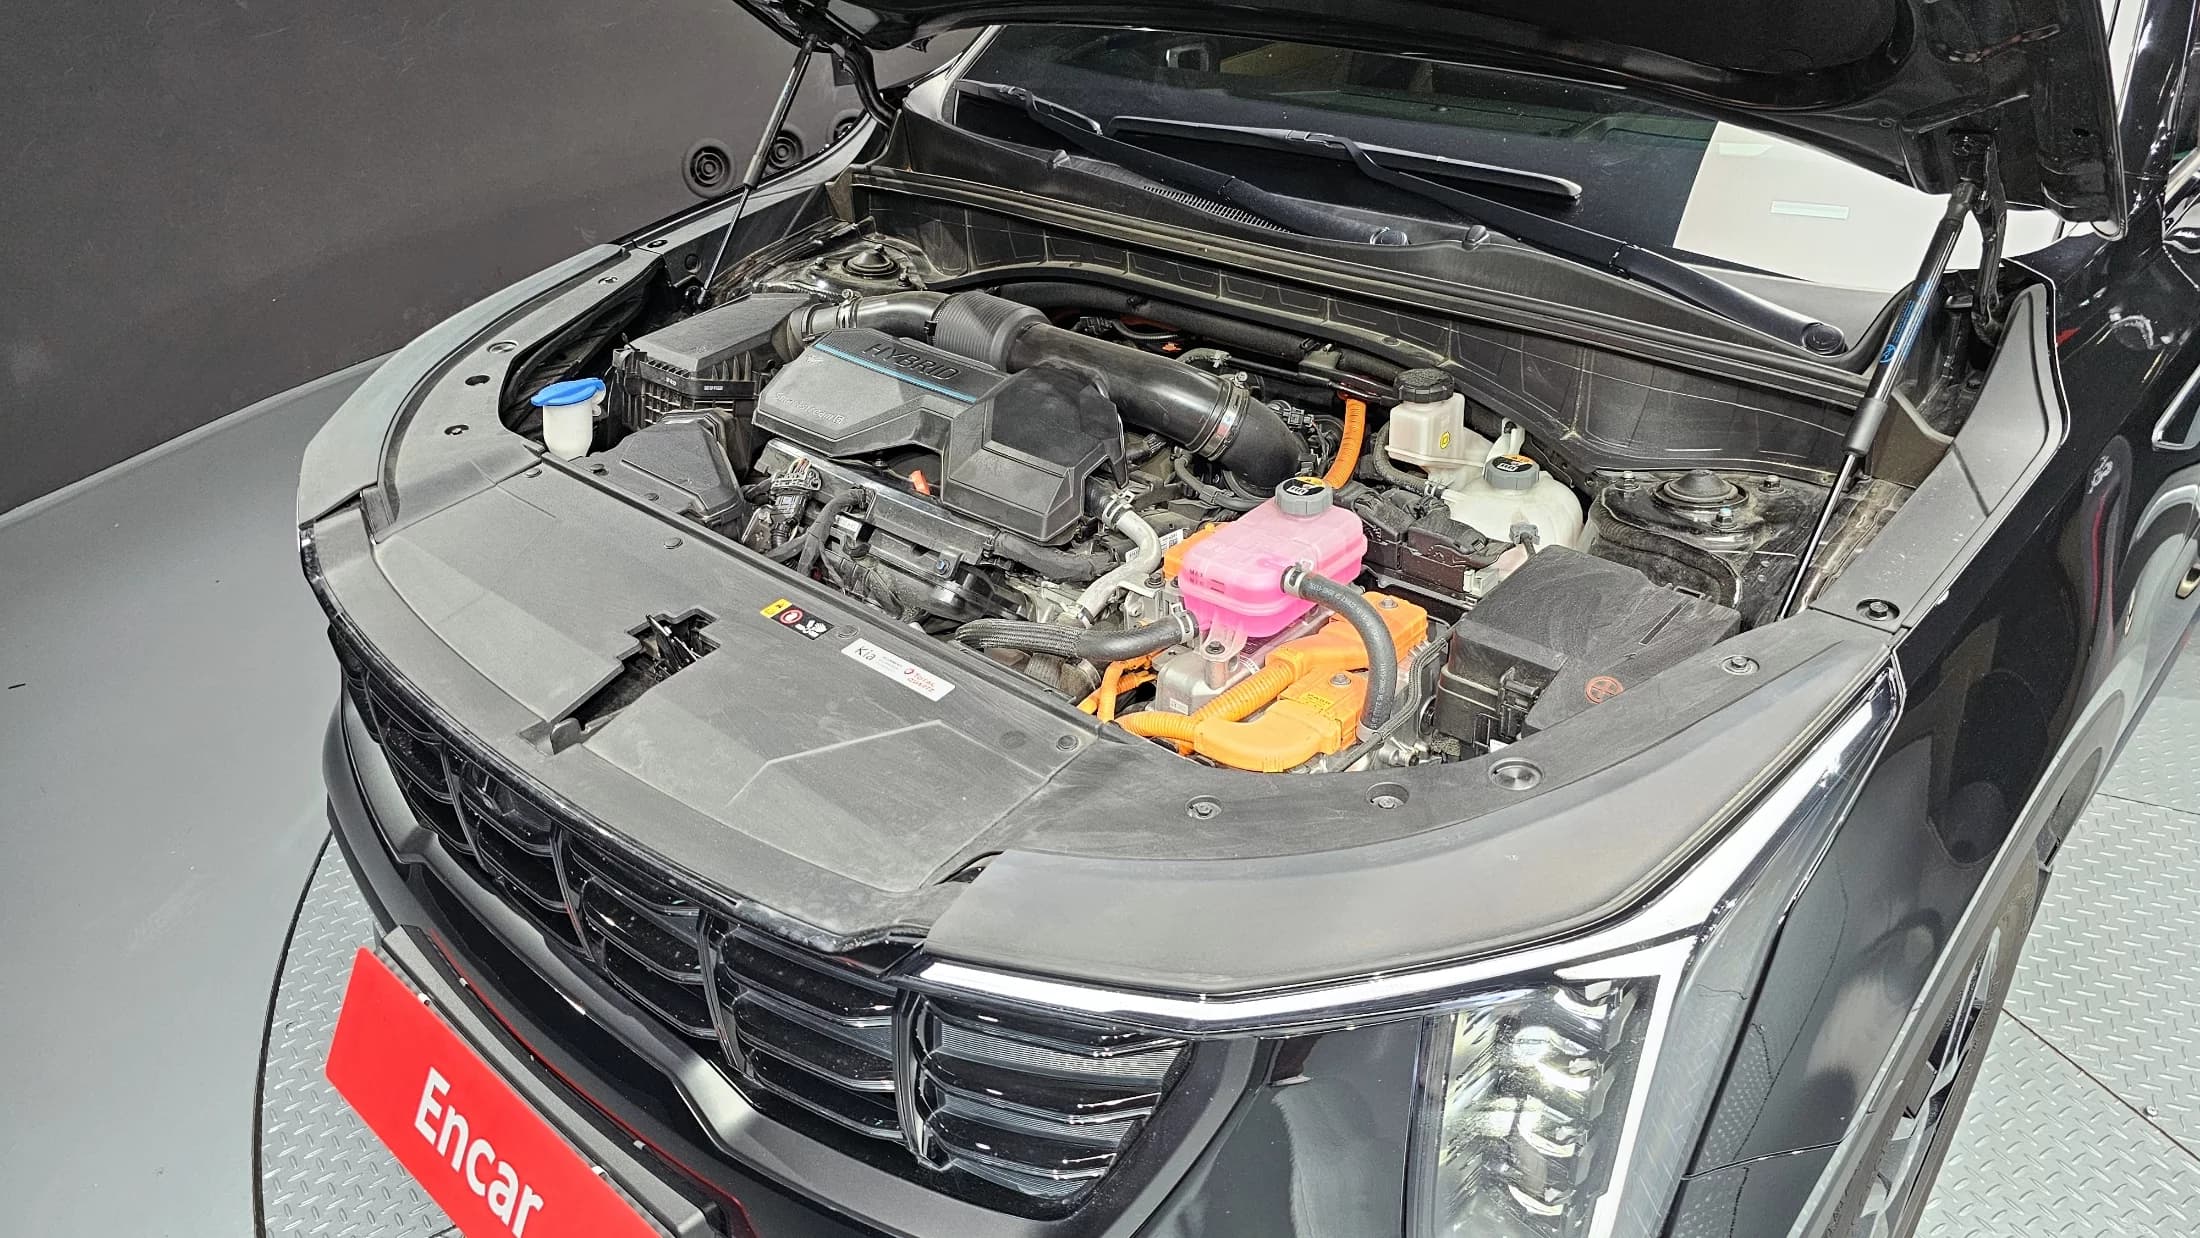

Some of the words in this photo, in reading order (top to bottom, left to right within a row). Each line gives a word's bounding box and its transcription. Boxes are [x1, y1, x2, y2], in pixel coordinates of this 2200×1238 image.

[862, 343, 959, 379] HYBRID
[855, 646, 877, 660] Kia
[913, 673, 935, 687] TOTAL
[414, 1066, 544, 1238] Encar
